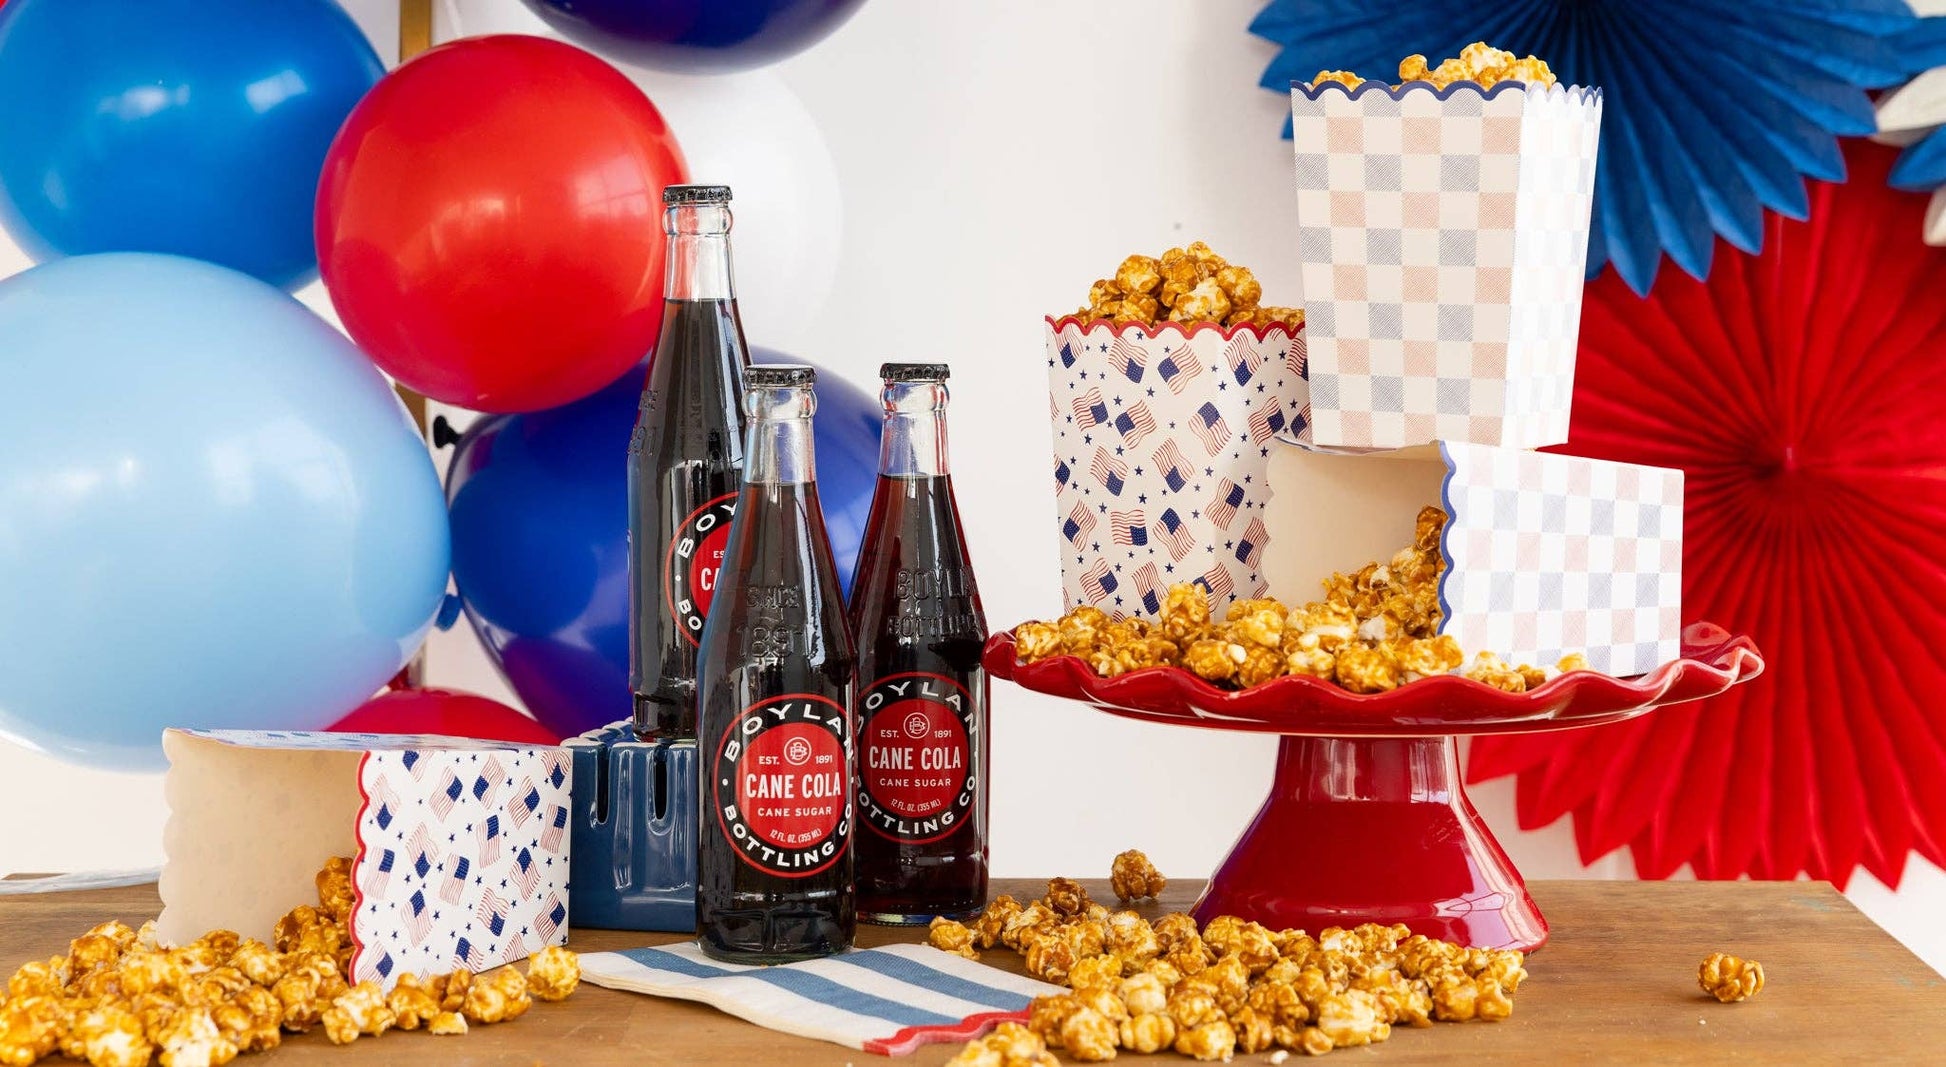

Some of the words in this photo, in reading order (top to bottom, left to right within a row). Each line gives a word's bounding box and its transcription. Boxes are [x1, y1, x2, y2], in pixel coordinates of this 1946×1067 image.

[677, 501, 738, 559] BOY
[880, 729, 900, 738] EST.
[934, 729, 952, 738] 1891
[758, 755, 780, 765] EST.
[815, 754, 833, 764] 1891
[869, 746, 914, 770] CANE
[921, 746, 961, 770] COLA
[745, 773, 795, 799] CANE
[802, 772, 842, 799] COLA
[879, 778, 909, 787] CANE
[914, 778, 951, 787] SUGAR
[757, 807, 790, 817] CANE
[795, 806, 832, 817] SUGAR
[857, 775, 954, 834] OTTLING
[724, 804, 835, 867] BOTTLING
